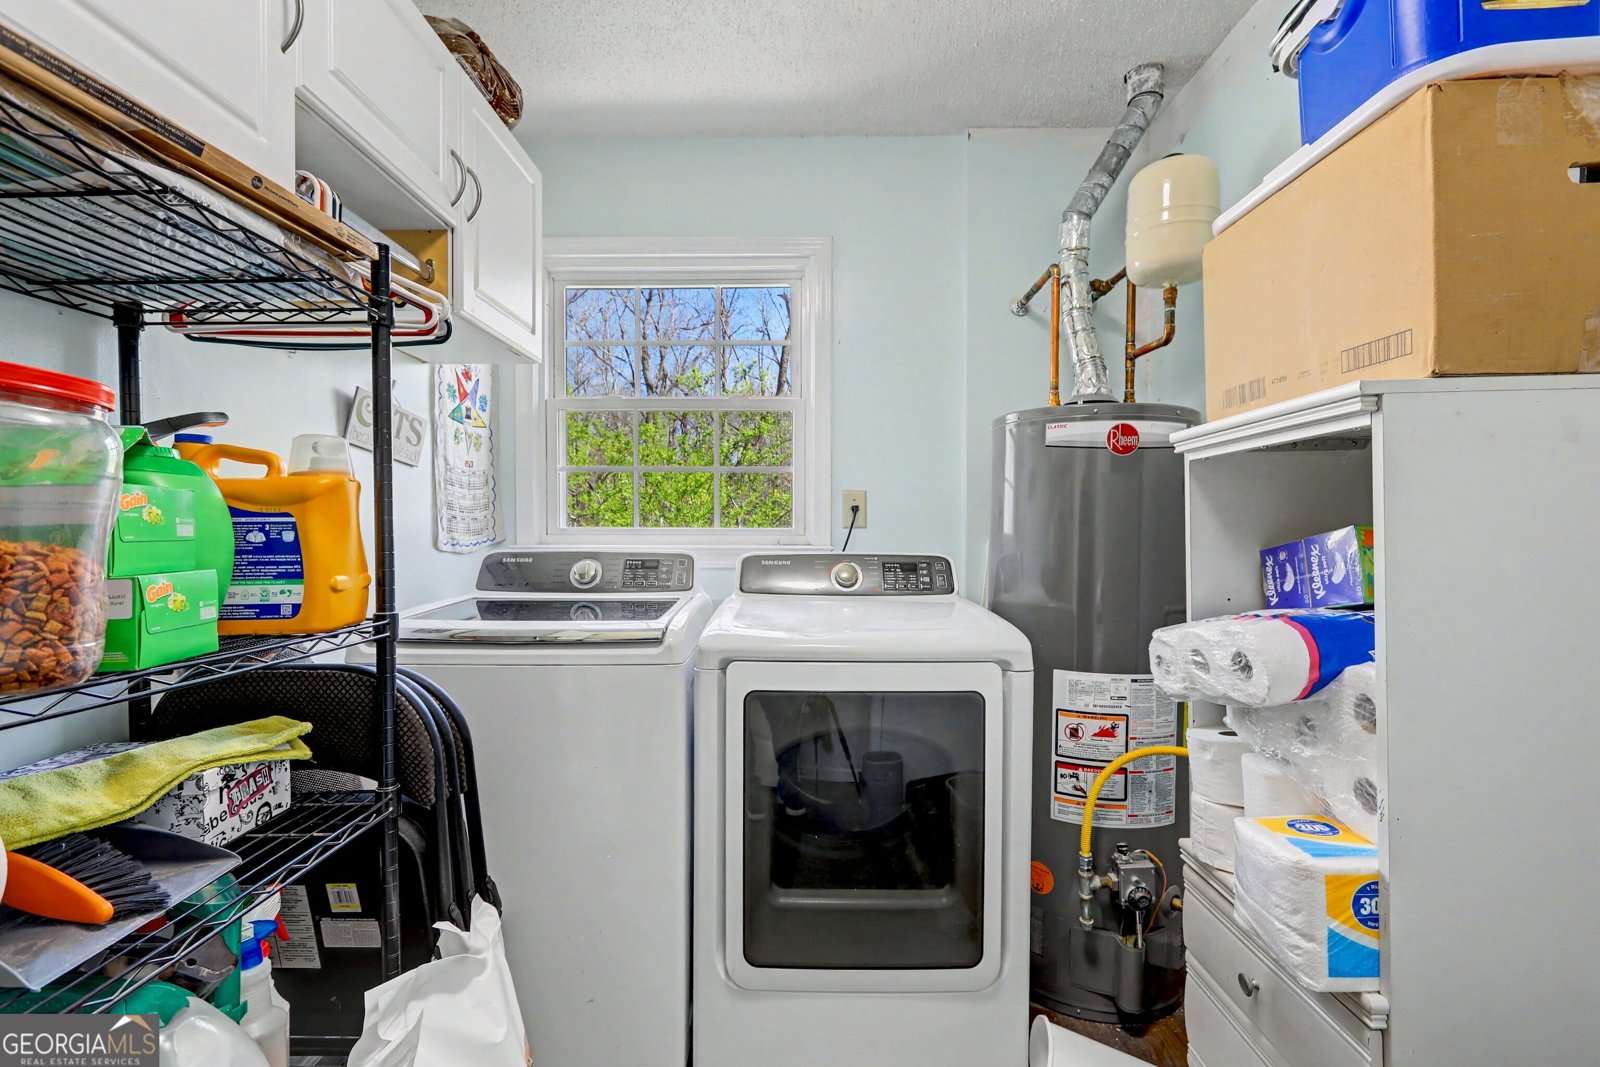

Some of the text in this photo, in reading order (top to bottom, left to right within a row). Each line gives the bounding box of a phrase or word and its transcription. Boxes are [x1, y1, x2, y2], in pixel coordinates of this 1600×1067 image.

[1110, 422, 1138, 450] Rheem
[120, 493, 148, 512] Gain
[1265, 555, 1279, 607] Kleenex
[1310, 543, 1327, 600] Kleenex
[146, 582, 173, 604] Gain
[1360, 897, 1379, 916] 30
